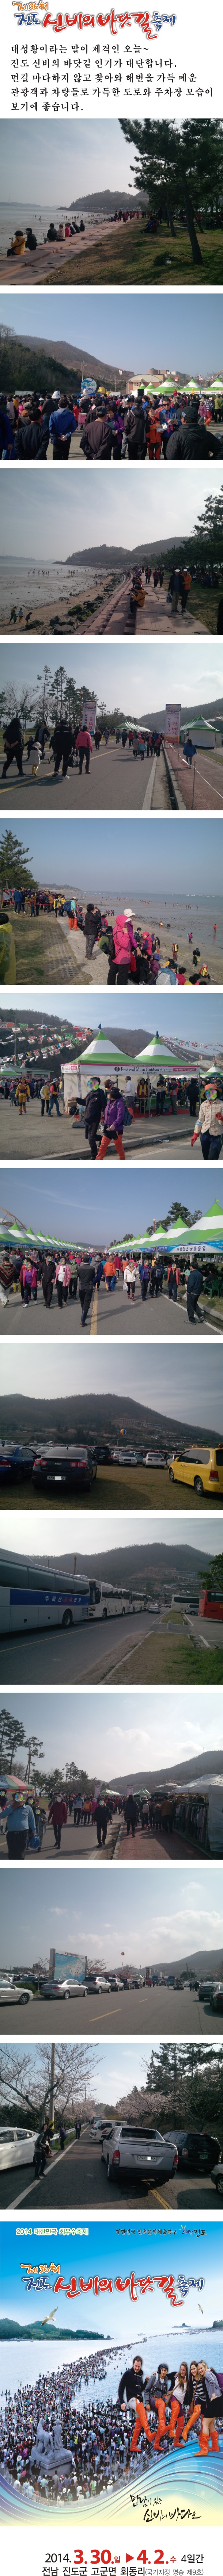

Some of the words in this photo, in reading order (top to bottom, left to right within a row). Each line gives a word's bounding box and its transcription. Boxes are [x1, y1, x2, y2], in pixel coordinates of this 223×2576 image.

[194, 2228, 208, 2238] 진도
[21, 2263, 60, 2274] 제36회
[23, 2277, 52, 2291] 진도
[54, 2276, 113, 2298] 신비의
[116, 2273, 183, 2306] 바닷길
[177, 2276, 204, 2297] 축제
[143, 2508, 167, 2523] 신비의
[169, 2507, 202, 2521] 바다로
[45, 2553, 72, 2563] 2014.
[181, 2554, 204, 2563] 4일간
[42, 2567, 59, 2576] 전남
[63, 2567, 88, 2576] 진도군
[91, 2567, 116, 2576] 고군면
